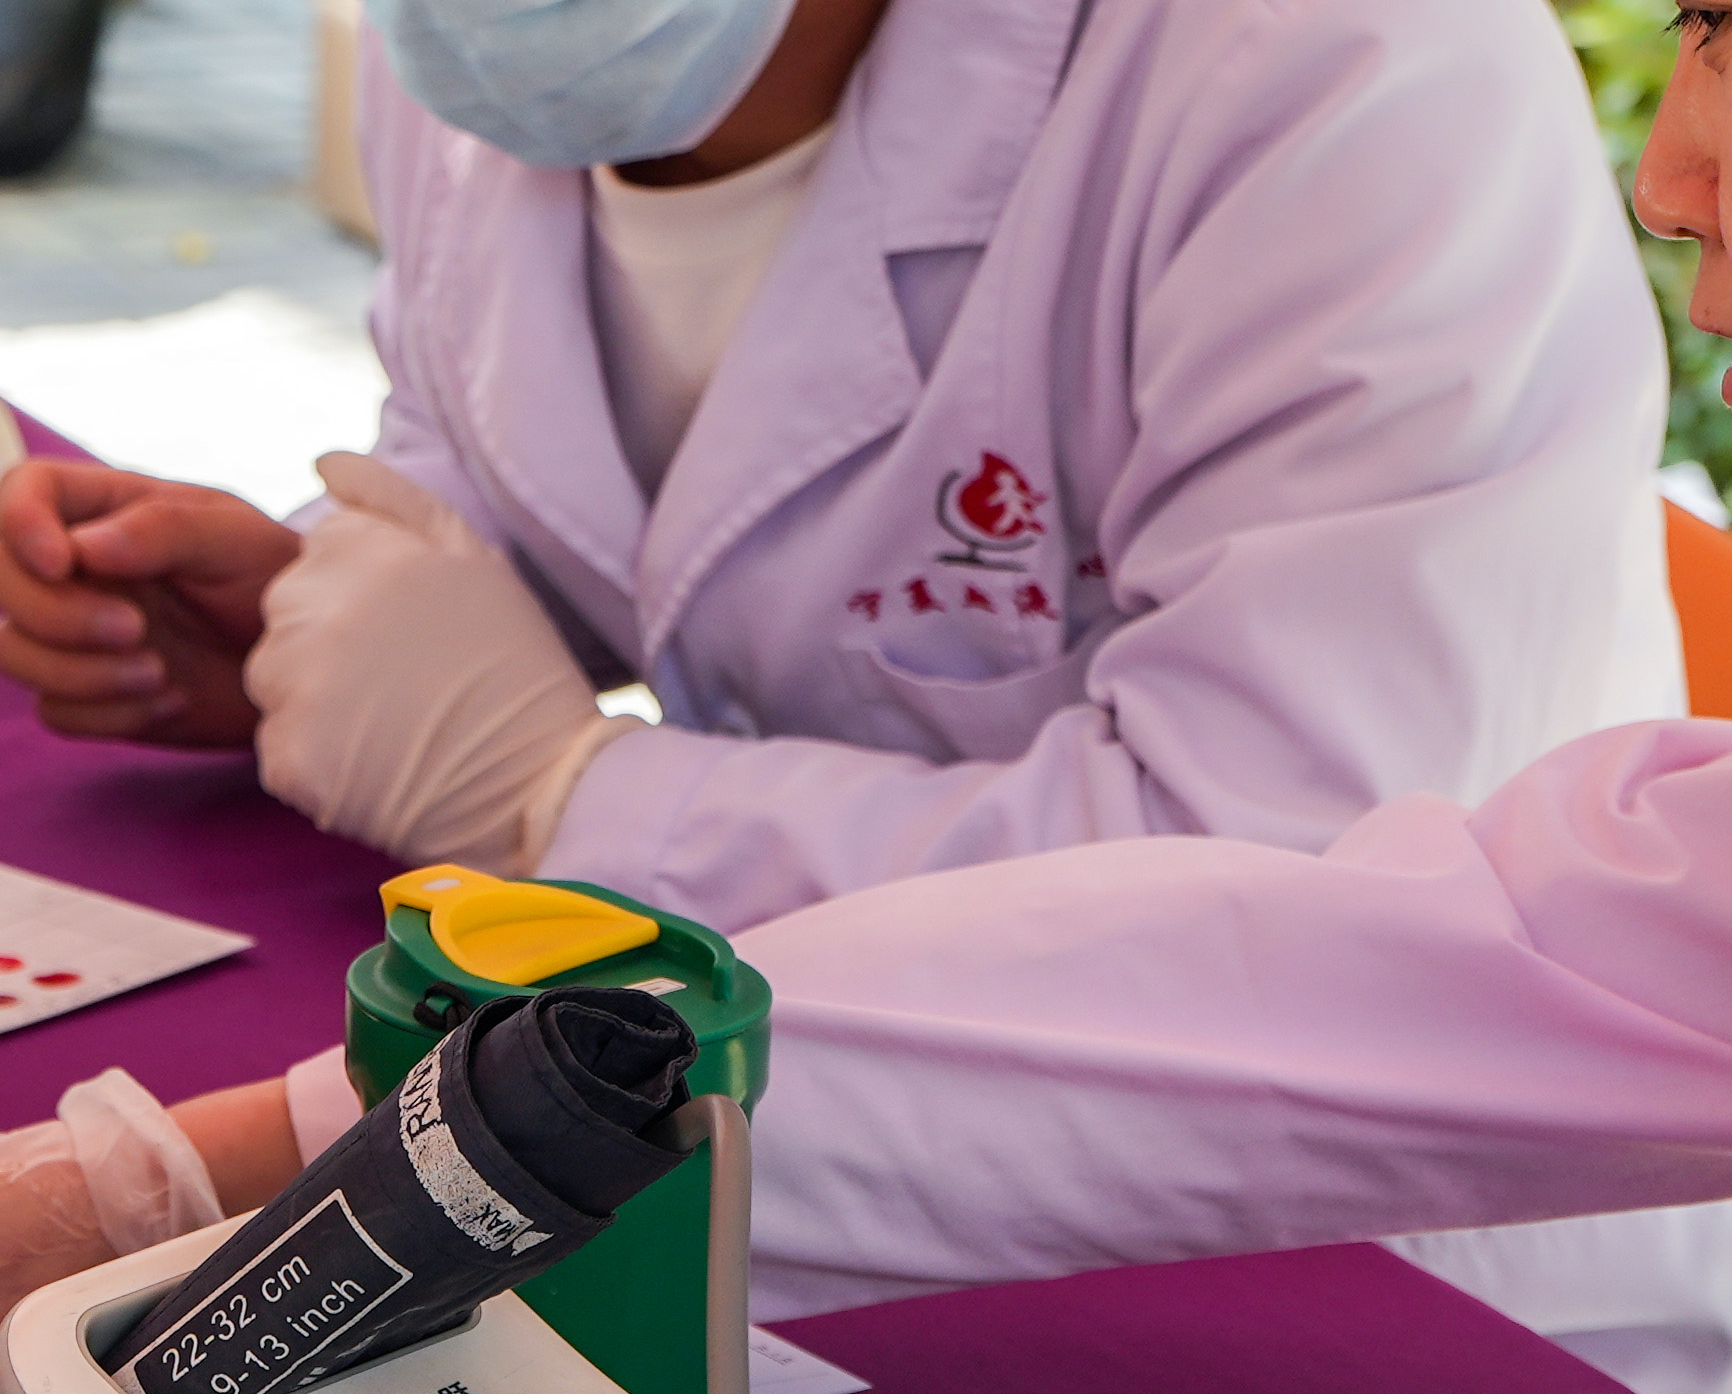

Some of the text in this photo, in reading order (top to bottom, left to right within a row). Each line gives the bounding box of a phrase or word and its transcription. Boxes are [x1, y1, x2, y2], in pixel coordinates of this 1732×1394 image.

[162, 1255, 312, 1382] 22-32 cm
[286, 1278, 366, 1338] inch
